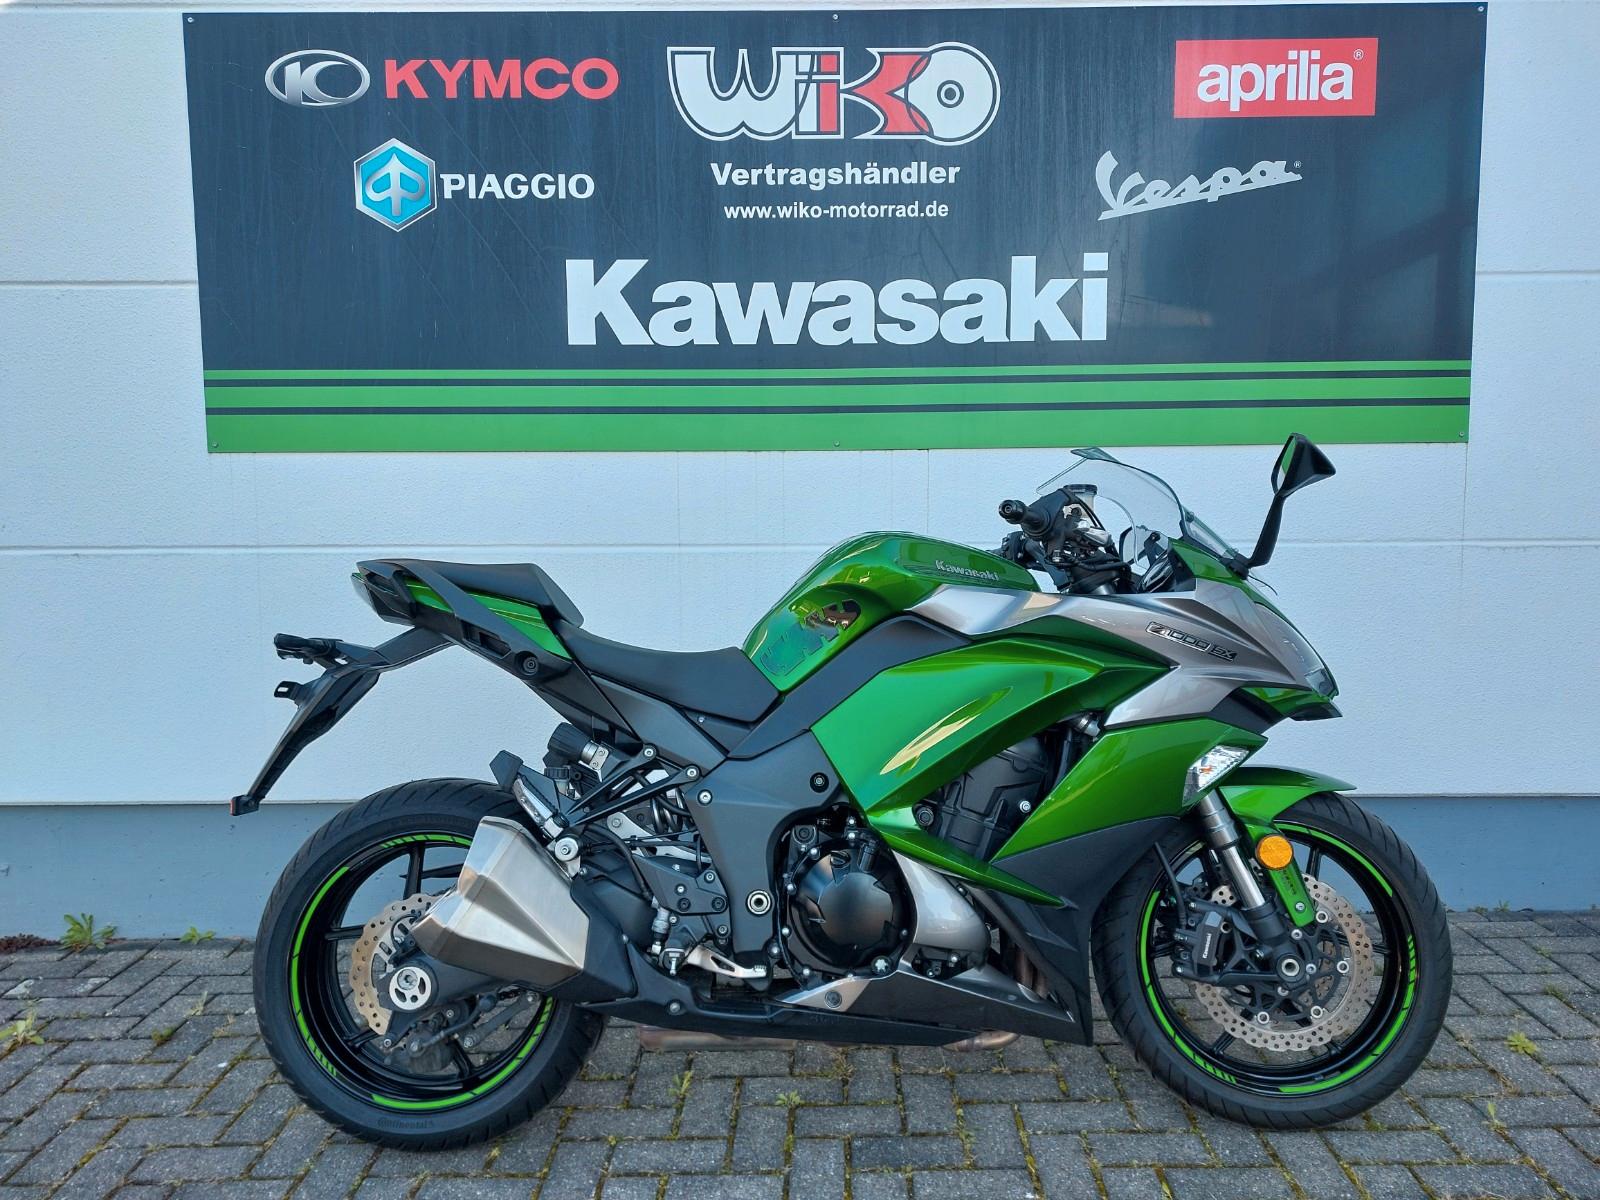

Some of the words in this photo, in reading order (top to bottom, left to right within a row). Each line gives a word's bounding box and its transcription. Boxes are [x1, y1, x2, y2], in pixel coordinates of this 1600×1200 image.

[384, 58, 620, 100] KYMCO
[1197, 49, 1354, 112] aprilia
[440, 173, 595, 200] PIAGGIO
[710, 161, 961, 191] Vertragshändler
[1097, 150, 1303, 221] Vespa
[723, 201, 949, 219] www.wiko-motorrad.de
[565, 251, 1109, 347] Kawasaki
[935, 559, 1000, 581] Kawasaki
